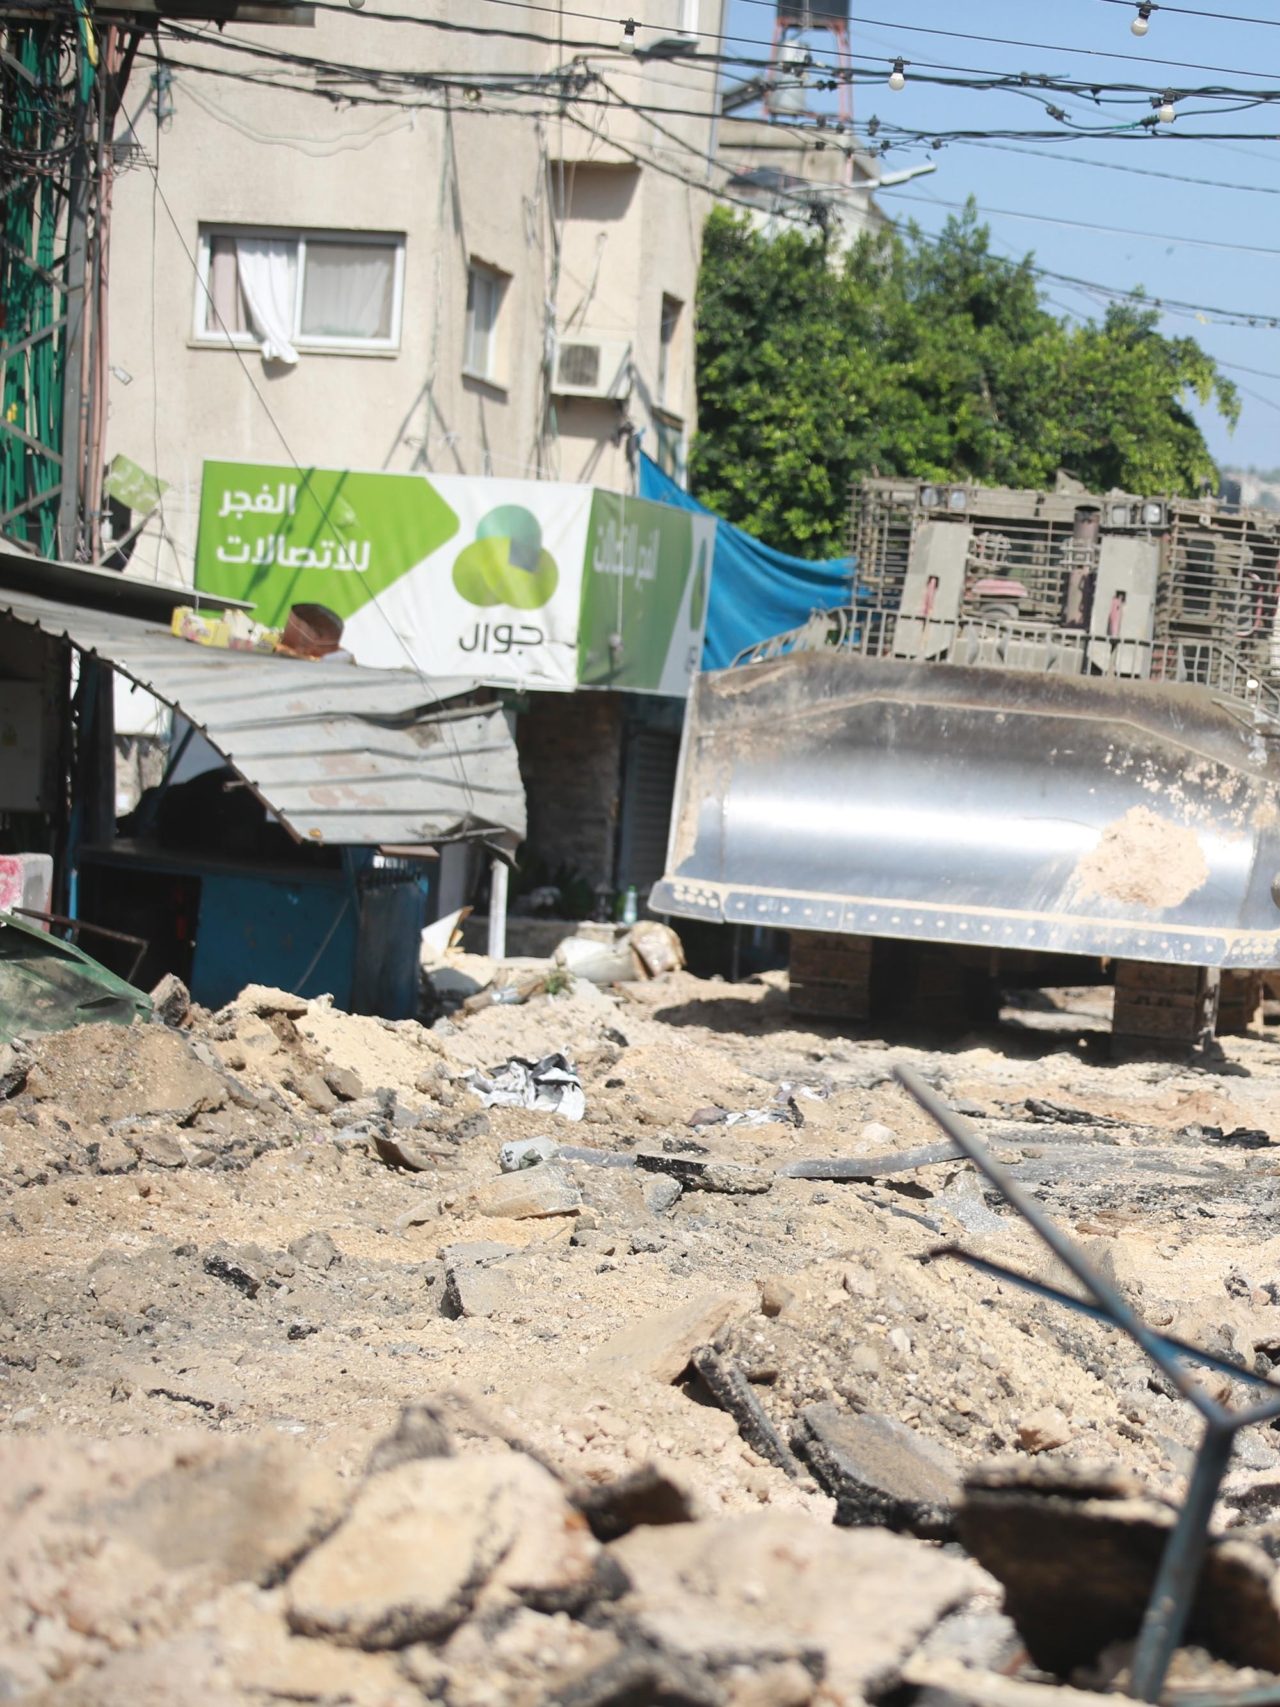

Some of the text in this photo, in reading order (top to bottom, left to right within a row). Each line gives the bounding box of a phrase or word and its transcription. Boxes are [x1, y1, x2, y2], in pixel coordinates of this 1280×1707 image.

[218, 483, 297, 520] الفجر
[216, 533, 371, 573] للاتصالات
[459, 622, 544, 655] جوال
